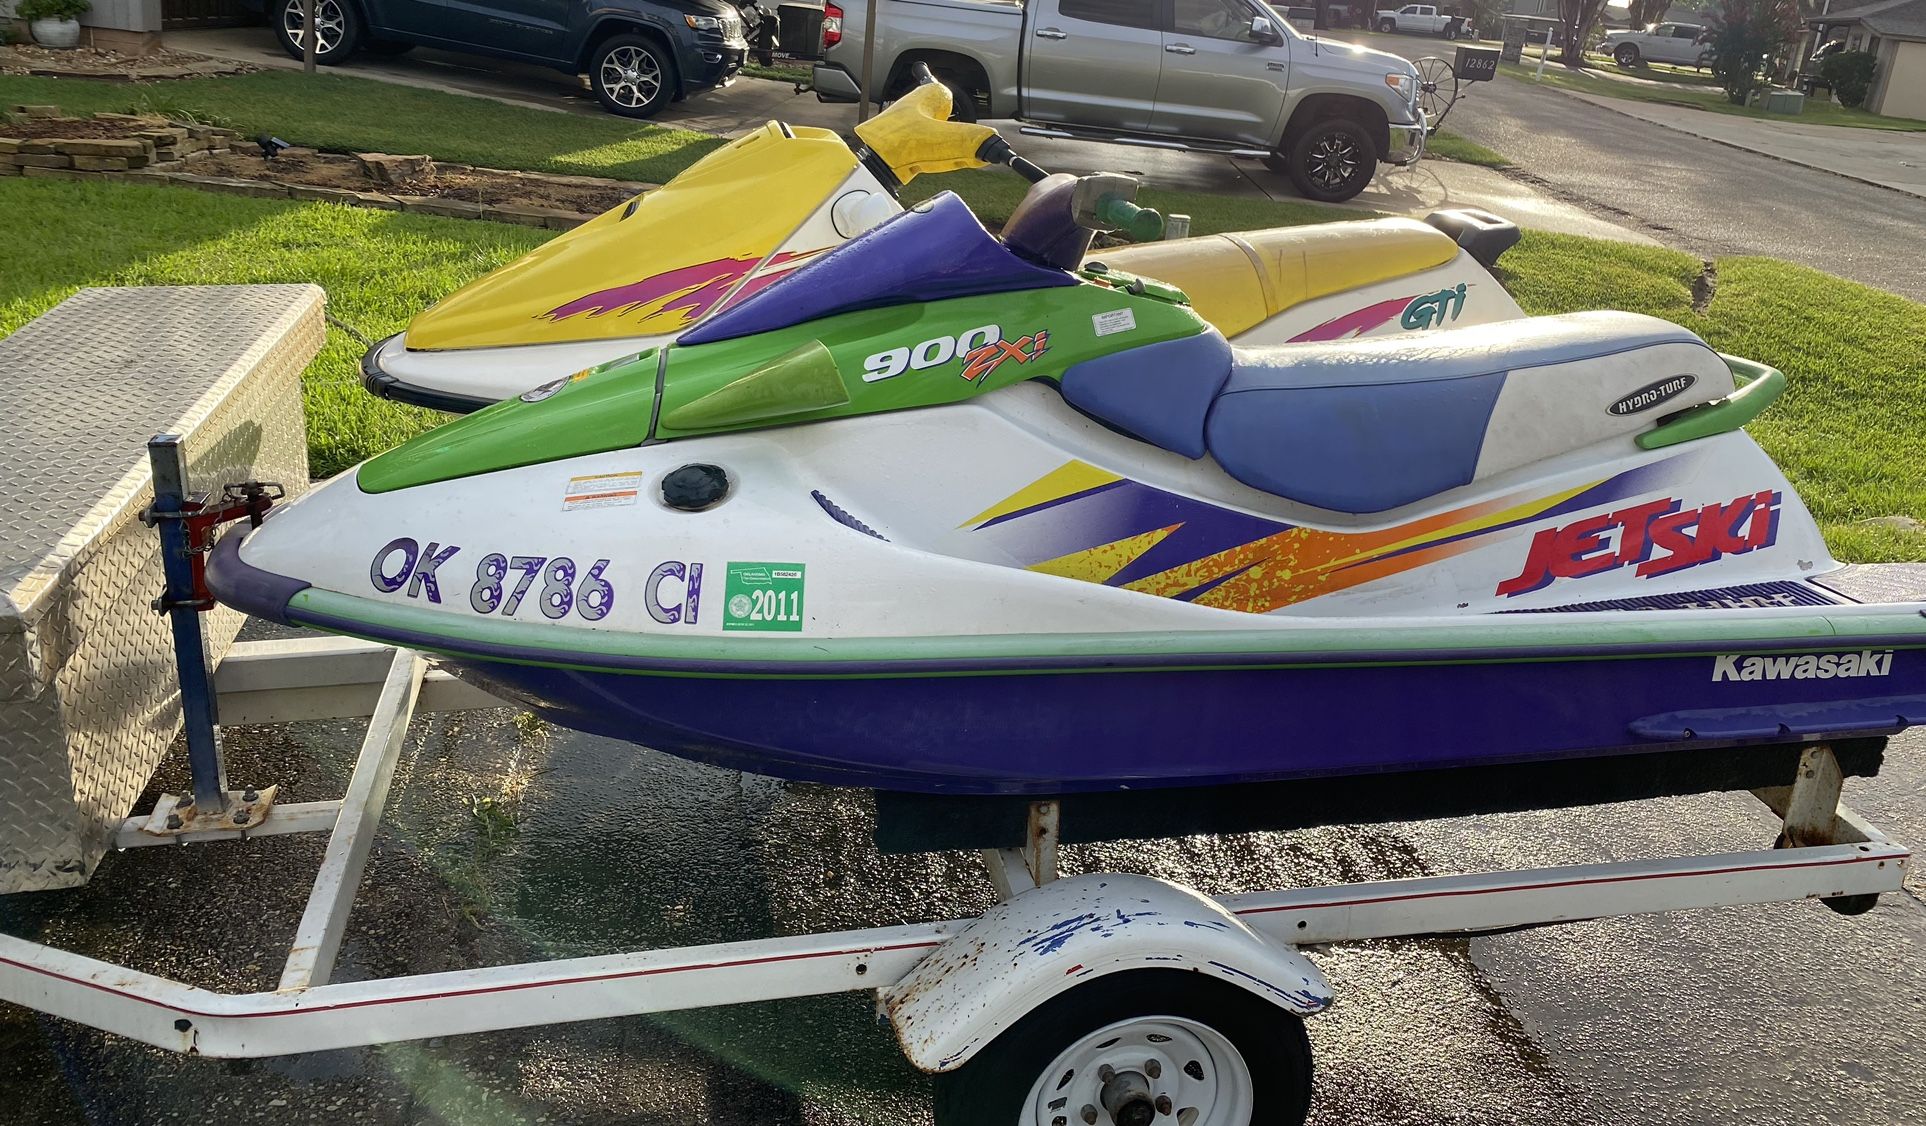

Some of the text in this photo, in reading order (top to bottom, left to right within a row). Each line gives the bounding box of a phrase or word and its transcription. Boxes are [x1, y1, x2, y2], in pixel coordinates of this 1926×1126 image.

[1465, 58, 1495, 70] 12862
[862, 324, 1002, 383] 900
[1618, 377, 1686, 413] HYDRO-TURF
[370, 537, 704, 624] OK 8786 CI
[750, 589, 800, 621] 2011
[1711, 650, 1894, 682] Kawasaki
